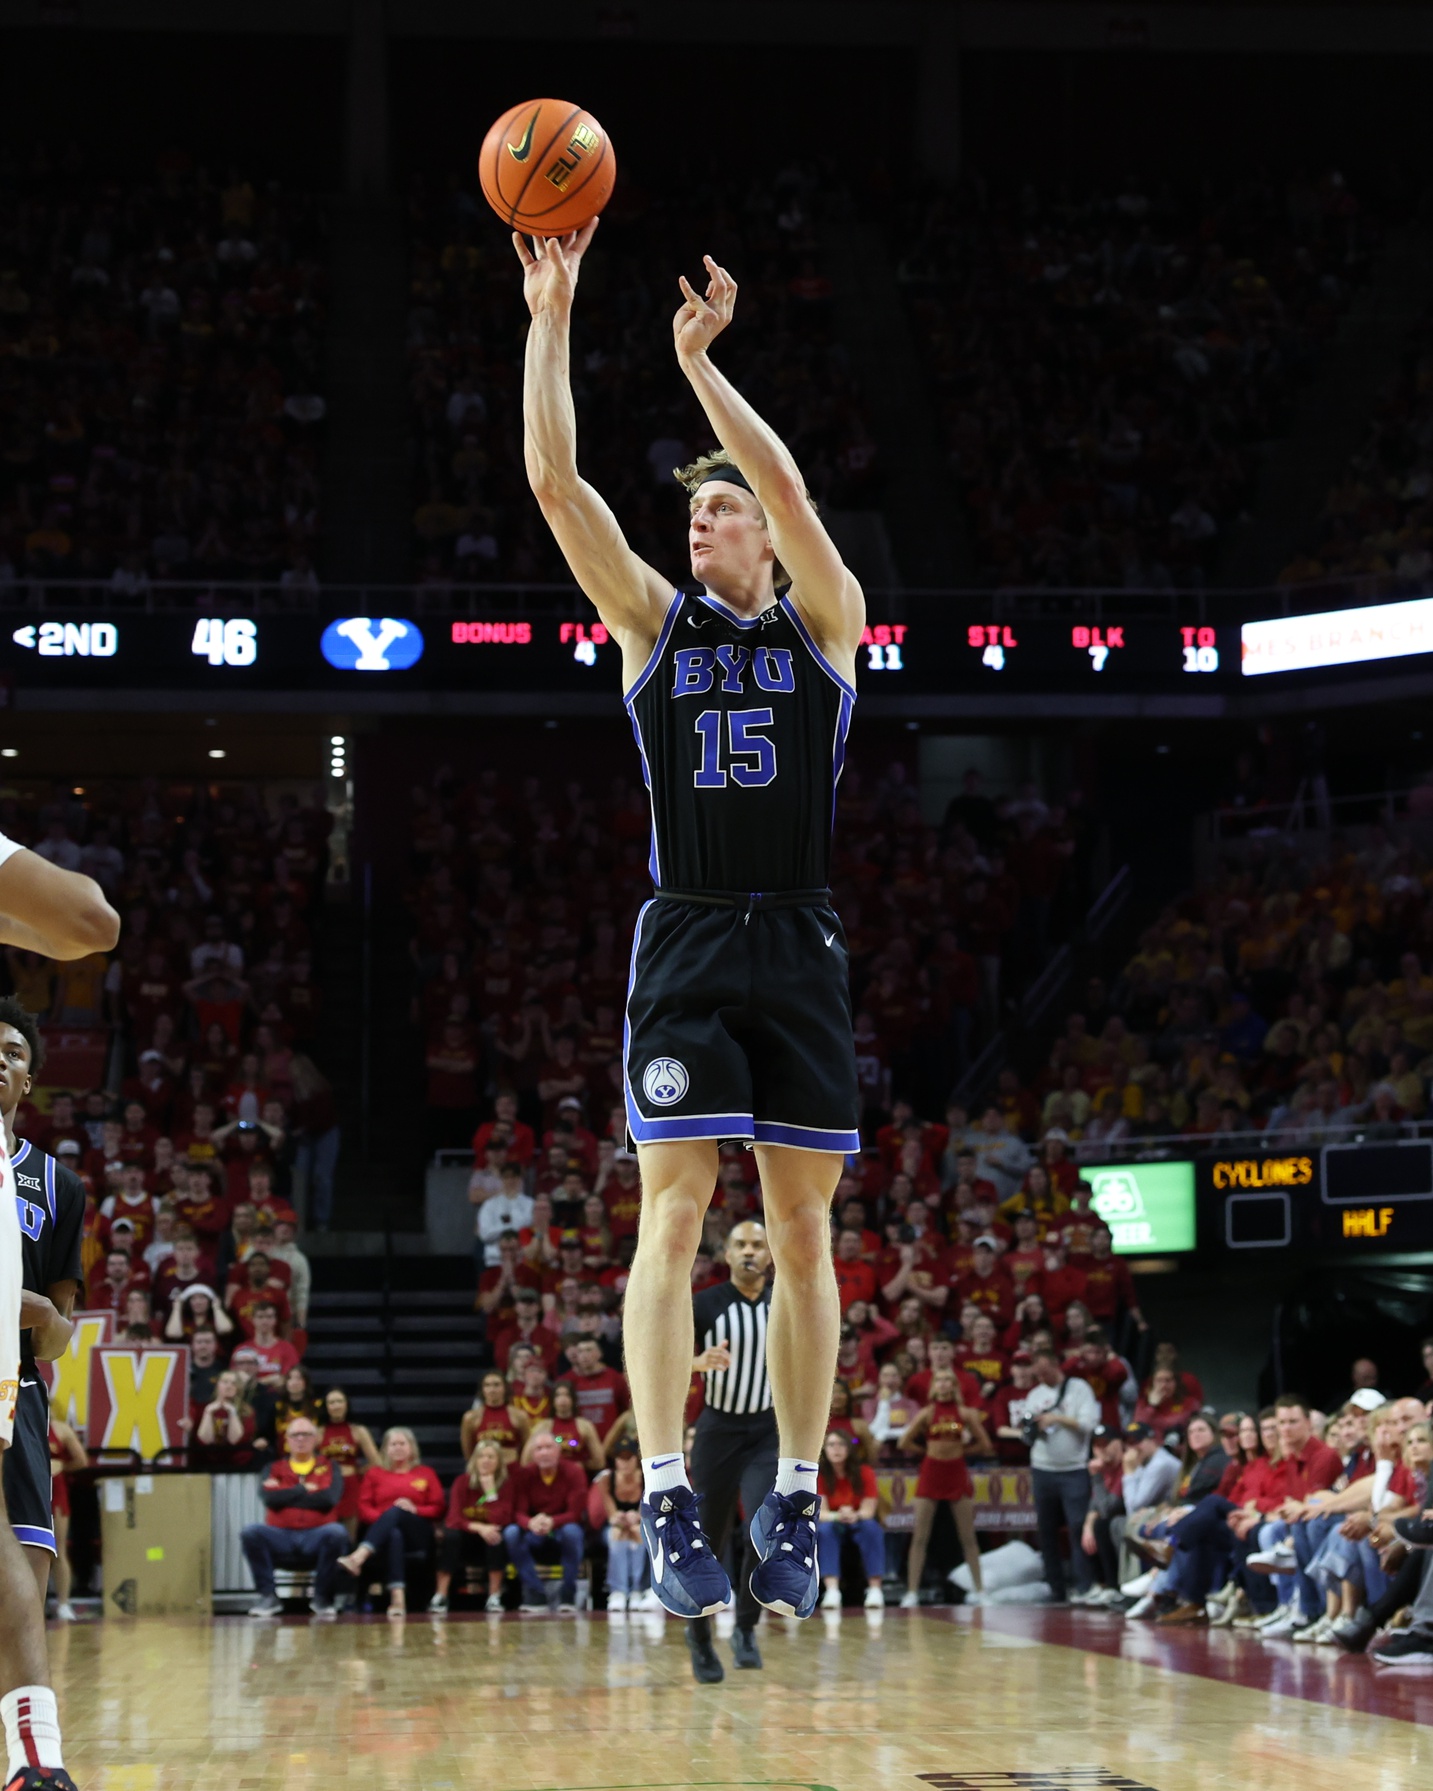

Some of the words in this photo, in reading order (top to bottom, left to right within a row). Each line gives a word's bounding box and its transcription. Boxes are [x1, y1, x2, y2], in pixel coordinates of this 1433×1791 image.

[544, 122, 600, 192] ELITE
[38, 622, 118, 656] 2ND
[191, 618, 257, 666] 46
[336, 617, 408, 670] Y
[452, 622, 531, 643] BONUS
[559, 623, 608, 644] FLS
[859, 625, 908, 646] AST
[968, 625, 1018, 647] STL
[1072, 626, 1124, 648] BLK
[1180, 627, 1215, 648] TO
[1309, 622, 1424, 651] BRANCH
[574, 641, 596, 666] 4
[868, 644, 903, 670] 11
[982, 645, 1005, 670] 4
[1088, 646, 1109, 671] 7
[1182, 646, 1218, 672] 10
[671, 645, 796, 699] BYU
[694, 707, 777, 788] 15
[1213, 1157, 1312, 1189] CYCLONES
[1343, 1208, 1394, 1238] HALF
[96, 1350, 178, 1466] X
